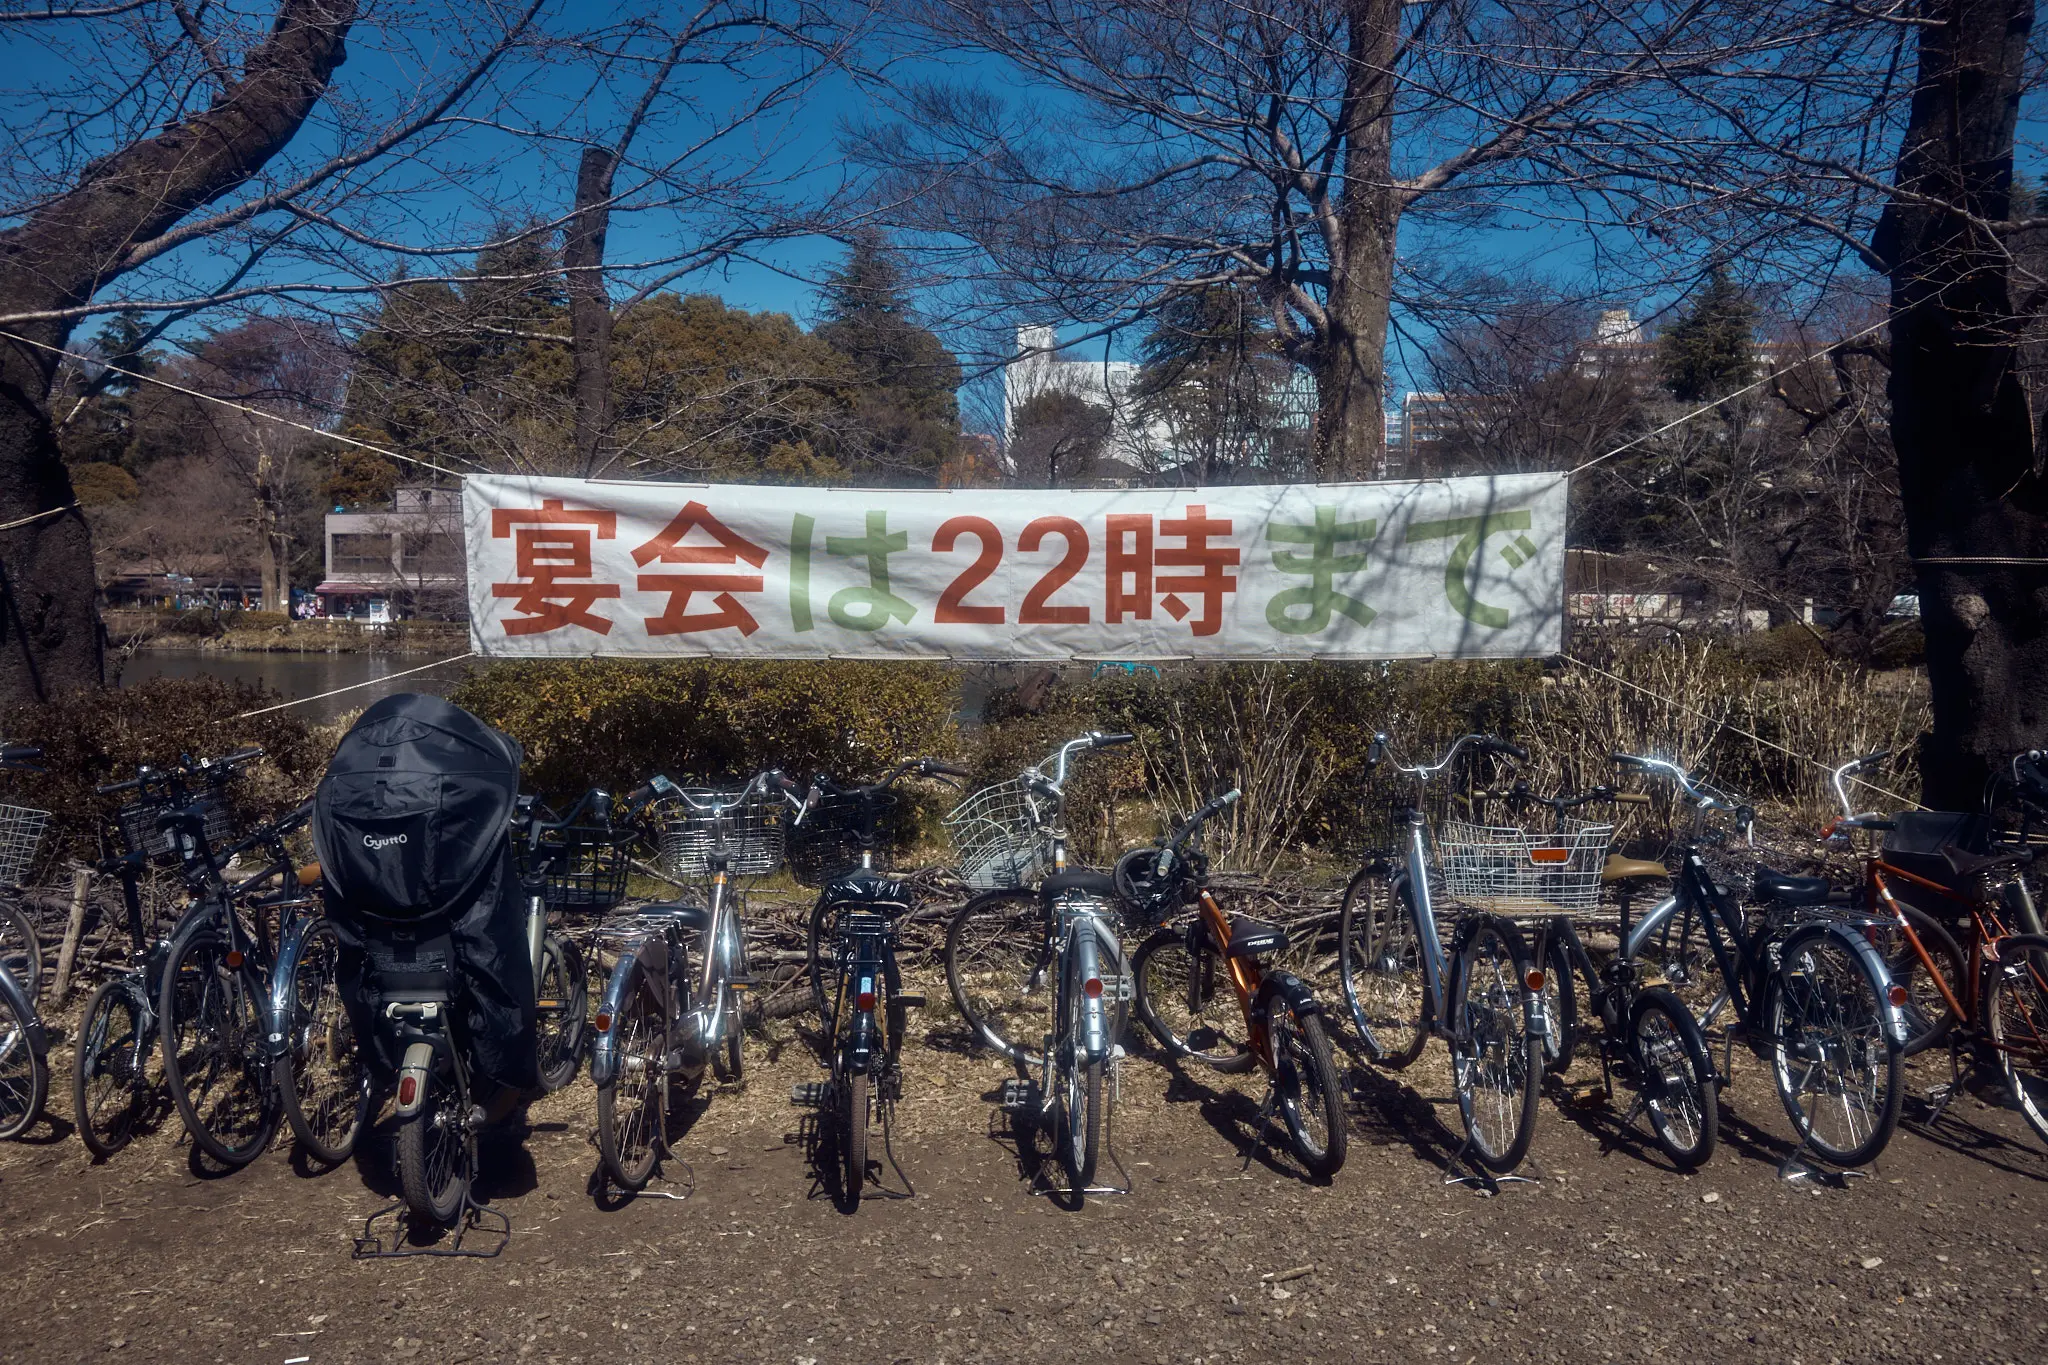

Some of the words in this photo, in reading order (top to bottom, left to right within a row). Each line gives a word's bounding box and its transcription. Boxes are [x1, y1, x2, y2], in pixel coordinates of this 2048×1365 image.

[491, 499, 1538, 637] 宴会は22時まで
